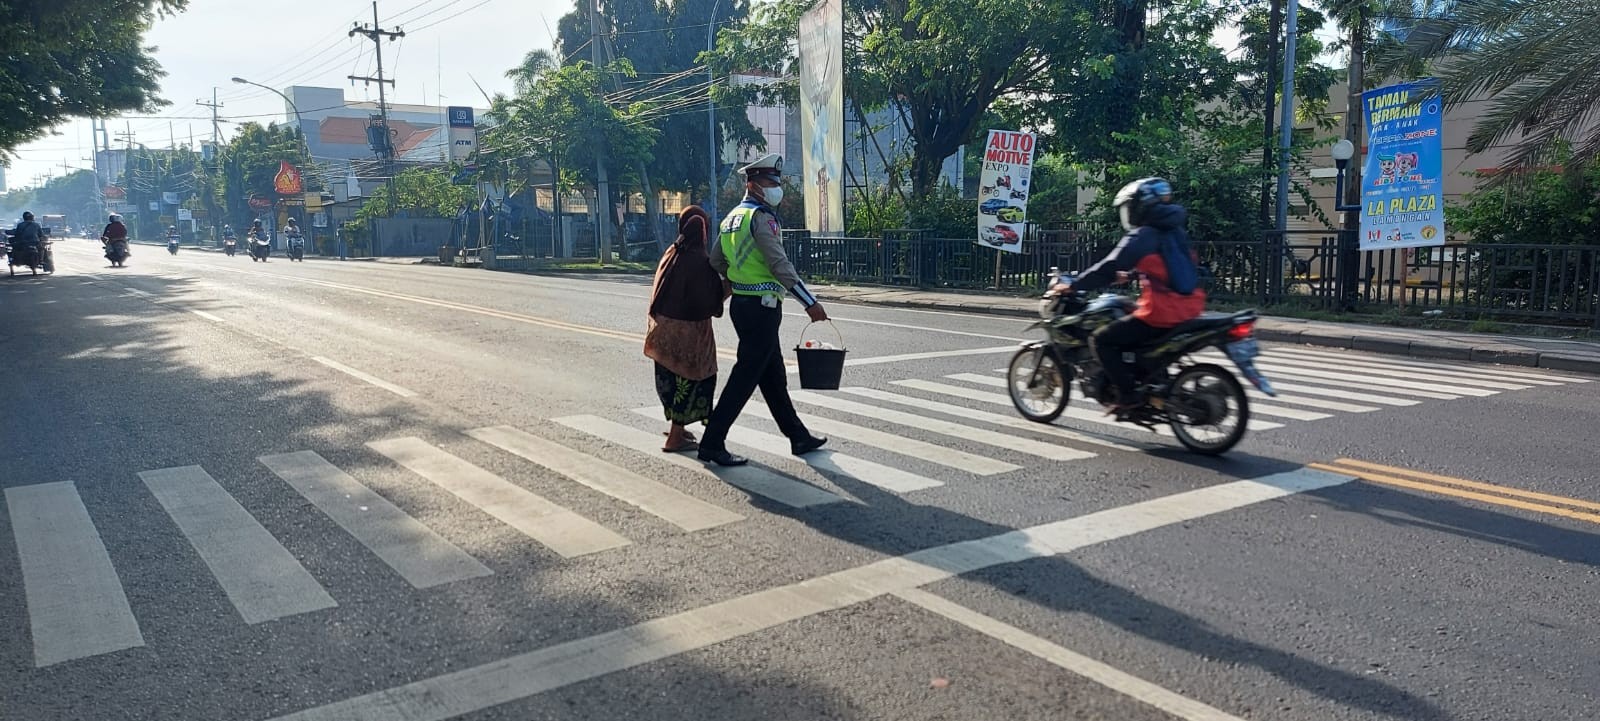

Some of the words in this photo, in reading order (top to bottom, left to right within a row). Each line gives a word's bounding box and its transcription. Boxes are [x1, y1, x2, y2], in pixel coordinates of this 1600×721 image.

[1368, 90, 1408, 111] TAMAN
[1371, 103, 1421, 125] BERMAIN
[989, 131, 1033, 152] AUTO
[985, 162, 1009, 173] EXPO
[986, 149, 1030, 165] MOTIVE
[1367, 200, 1384, 216] LA
[1389, 194, 1436, 214] PLAZA
